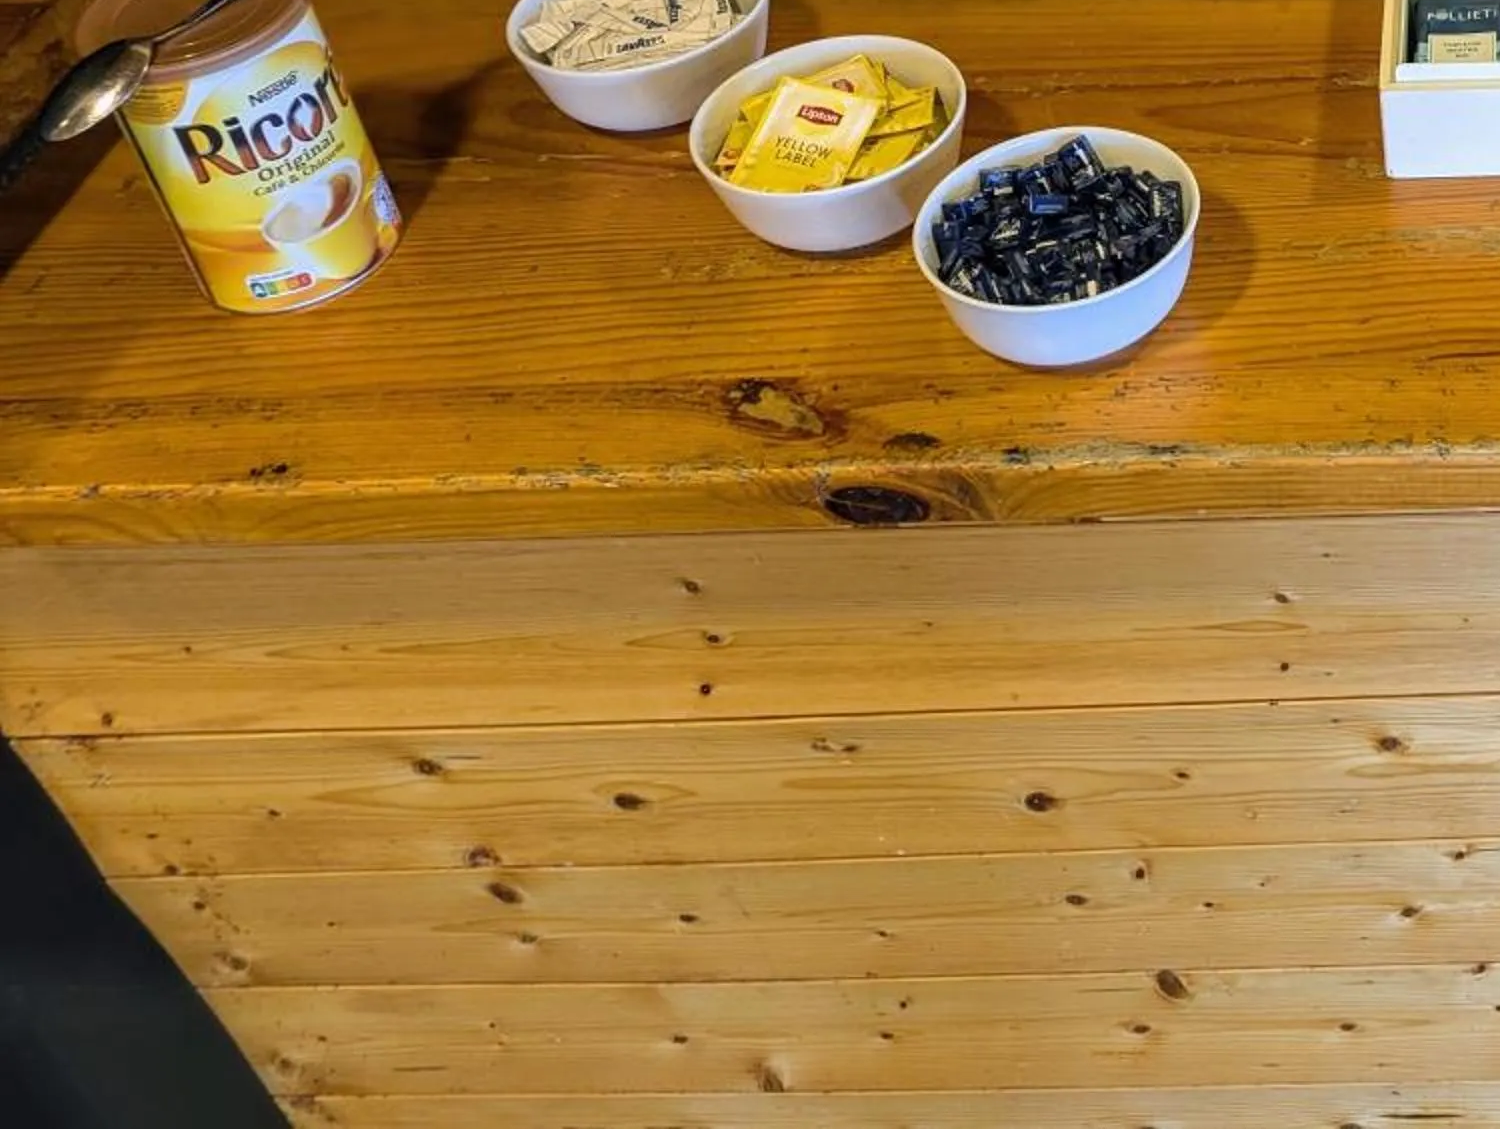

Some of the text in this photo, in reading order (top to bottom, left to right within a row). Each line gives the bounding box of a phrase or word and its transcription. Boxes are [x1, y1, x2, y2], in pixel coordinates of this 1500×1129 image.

[801, 107, 839, 124] Lipton
[258, 133, 336, 183] Original
[775, 136, 833, 160] YELLOW
[775, 148, 818, 169] LABEL
